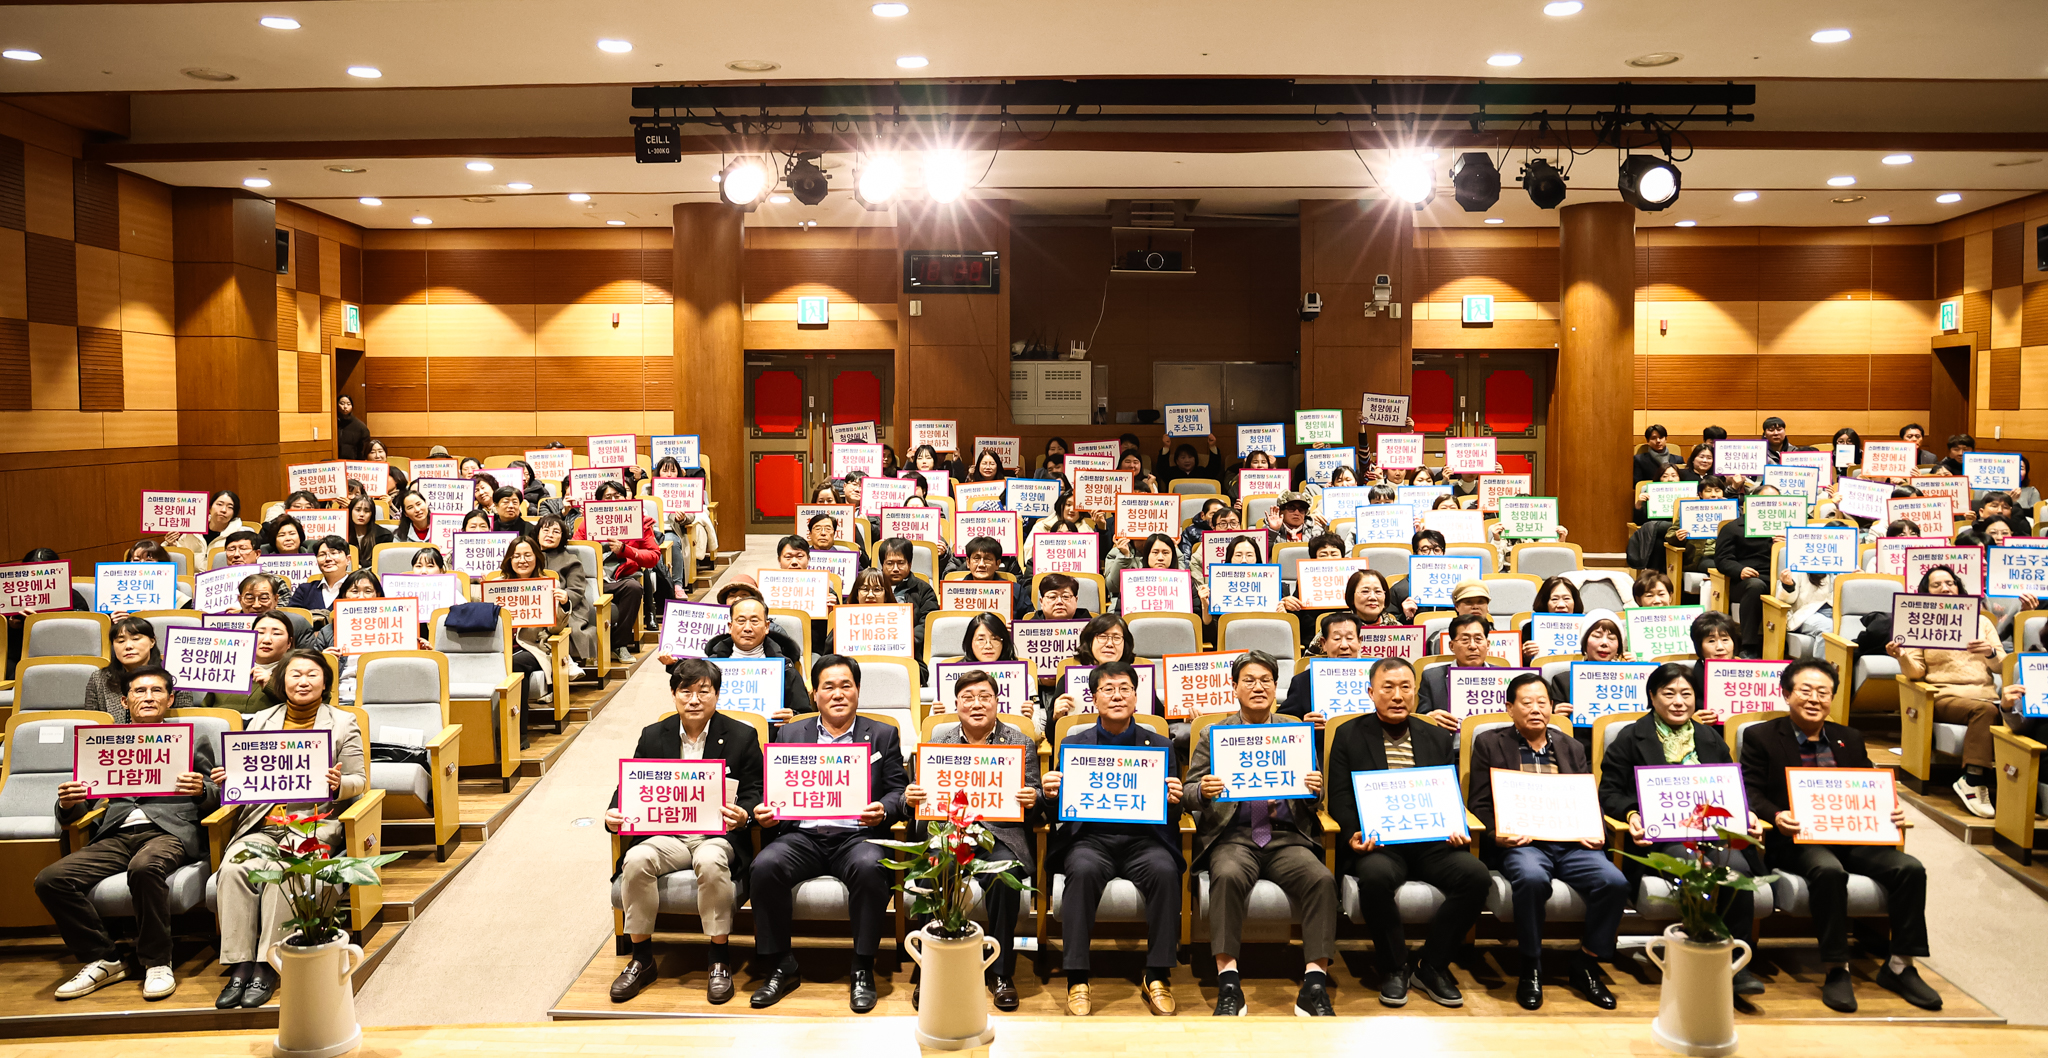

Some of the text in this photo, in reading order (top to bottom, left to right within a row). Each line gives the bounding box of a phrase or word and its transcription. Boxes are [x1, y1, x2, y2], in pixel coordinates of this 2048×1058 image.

[646, 135, 670, 144] CEIL.L
[1370, 404, 1400, 413] 청양에서
[1178, 415, 1198, 423] 청양에
[1370, 413, 1399, 422] 식사하자
[1174, 424, 1203, 432] 주소두자
[1305, 421, 1334, 429] 청양에서
[1309, 431, 1331, 439] 장보자
[598, 446, 627, 454] 청양에서
[1387, 446, 1416, 454] 청양에서
[1457, 450, 1487, 458] 청양에서
[843, 456, 873, 464] 청양에서
[1390, 456, 1412, 464] 다함께
[1725, 452, 1757, 460] 청양에서
[1873, 453, 1906, 462] 청양에서
[532, 461, 563, 470] 청양에서
[1460, 460, 1483, 468] 다함께
[1872, 463, 1906, 472] 공부하자
[1980, 466, 2005, 474] 청양에
[299, 474, 335, 486] 청양에서
[1975, 476, 2009, 485] 주소두자
[429, 491, 463, 500] 청양에서
[663, 490, 694, 499] 청양에서
[872, 490, 905, 500] 청양에서
[1021, 492, 1045, 501] 청양에
[1849, 491, 1882, 503] 청양에서
[667, 500, 690, 508] 다함께
[1015, 503, 1049, 512] 주소두자
[1849, 502, 1882, 513] 식사하자
[154, 505, 195, 515] 청양에서
[1128, 509, 1167, 519] 청양에서
[1758, 510, 1796, 519] 청양에서
[596, 514, 632, 524] 청양에서
[1511, 511, 1547, 520] 청양에서
[1696, 513, 1721, 523] 청양에
[1900, 511, 1941, 522] 청양에서
[159, 517, 190, 527] 다함께
[892, 521, 928, 531] 청양에서
[1372, 519, 1398, 528] 청양에
[601, 526, 628, 536] 다함께
[967, 527, 1005, 537] 청양에서
[1128, 522, 1168, 534] 공부하자
[1516, 523, 1543, 532] 장보자
[1368, 530, 1404, 539] 주소두자
[1806, 543, 1837, 553] 청양에
[1047, 549, 1086, 559] 청양에서
[1800, 556, 1843, 566] 주소두자
[1052, 561, 1082, 572] 다함께
[1429, 573, 1461, 584] 청양에
[2009, 569, 2045, 581] 청양에
[3, 578, 56, 594] 청양에서
[117, 580, 154, 591] 청양에
[1228, 581, 1260, 592] 청양에
[771, 586, 814, 597] 청양에서
[1136, 586, 1178, 600] 청양에서
[11, 593, 50, 607] 다함께
[111, 594, 160, 605] 주소두자
[496, 595, 541, 607] 청양에서
[954, 597, 998, 610] 청양에서
[1223, 596, 1267, 607] 주소두자
[1141, 600, 1174, 611] 다함께
[351, 616, 402, 631] 청양에서
[849, 612, 898, 625] 공부하자
[1908, 612, 1962, 626] 청양에서
[850, 628, 898, 640] 청양에서
[1908, 628, 1962, 642] 식사하자
[174, 636, 212, 645] 스마트청양
[352, 632, 403, 647] 공부하자
[1651, 641, 1690, 654] 장보자
[181, 648, 236, 665] 청양에서
[1172, 662, 1208, 671] 스마트청양
[180, 667, 235, 683] 식사하자
[1714, 669, 1752, 677] 스마트청양
[1596, 685, 1636, 699] 청양에
[1182, 690, 1235, 708] 공부하자
[86, 735, 135, 744] 스마트청양
[1221, 736, 1263, 746] 스마트청양
[232, 741, 277, 751] 스마트청양
[98, 748, 170, 766] 청양에서
[774, 756, 817, 764] 스마트청양
[928, 755, 971, 765] 스마트청양
[1071, 757, 1114, 766] 스마트청양
[1240, 750, 1285, 768] 청양에
[243, 754, 310, 772] 청양에서
[108, 769, 161, 785] 다함께
[629, 771, 672, 780] 스마트청양
[785, 770, 849, 787] 청양에서
[937, 770, 1002, 790] 청양에서
[1090, 772, 1137, 789] 청양에
[1232, 771, 1295, 789] 주소두자
[243, 775, 312, 792] 식사하자
[1365, 781, 1406, 791] 스마트청양
[1647, 777, 1690, 786] 스마트청양
[1799, 780, 1842, 788] 스마트청양
[640, 785, 704, 802] 청양에서
[793, 791, 841, 808] 다함께
[1080, 793, 1146, 811] 주소두자
[1385, 793, 1433, 811] 청양에
[1660, 792, 1725, 810] 청양에서
[1811, 794, 1876, 811] 청양에서
[648, 806, 696, 823] 다함께
[1381, 812, 1445, 832] 주소두자
[1814, 815, 1879, 832] 공부하자
